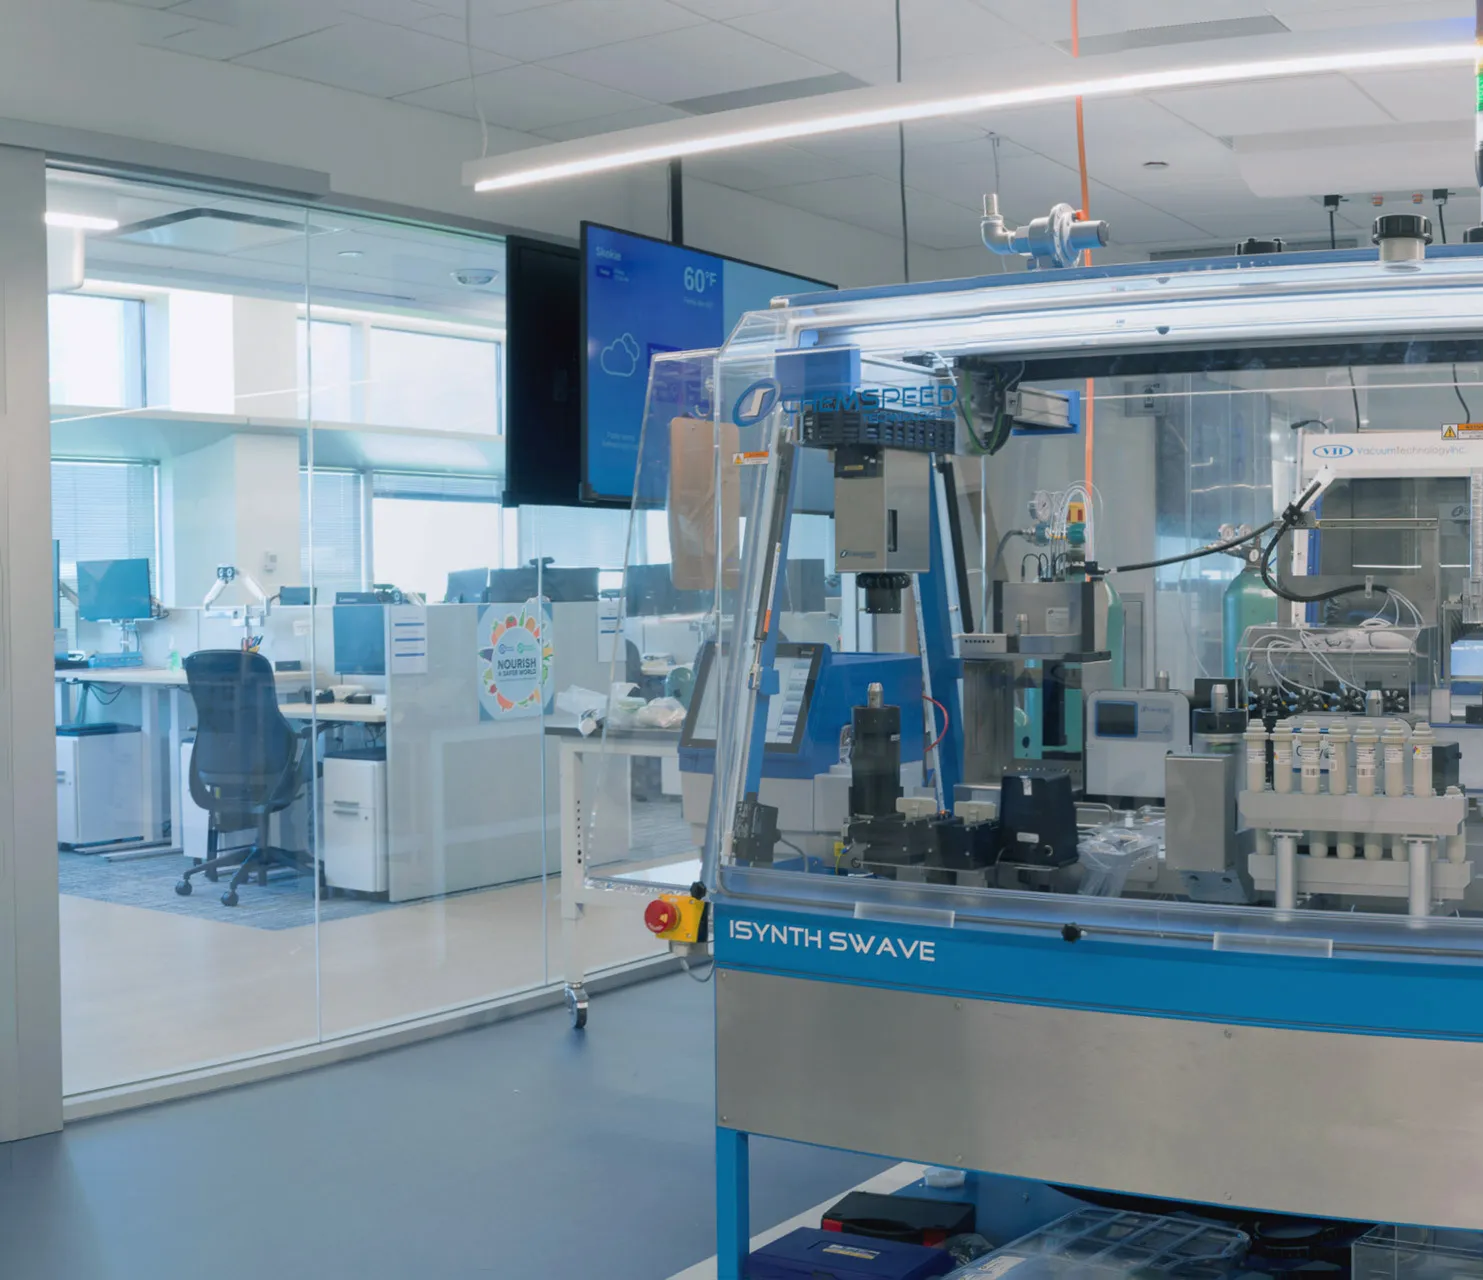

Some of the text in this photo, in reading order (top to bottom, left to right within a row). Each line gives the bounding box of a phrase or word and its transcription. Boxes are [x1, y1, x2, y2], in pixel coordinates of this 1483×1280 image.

[782, 385, 957, 415] CHEMSPEED
[497, 658, 537, 671] NOURISH
[729, 919, 936, 962] ISYNTH SWAVE
